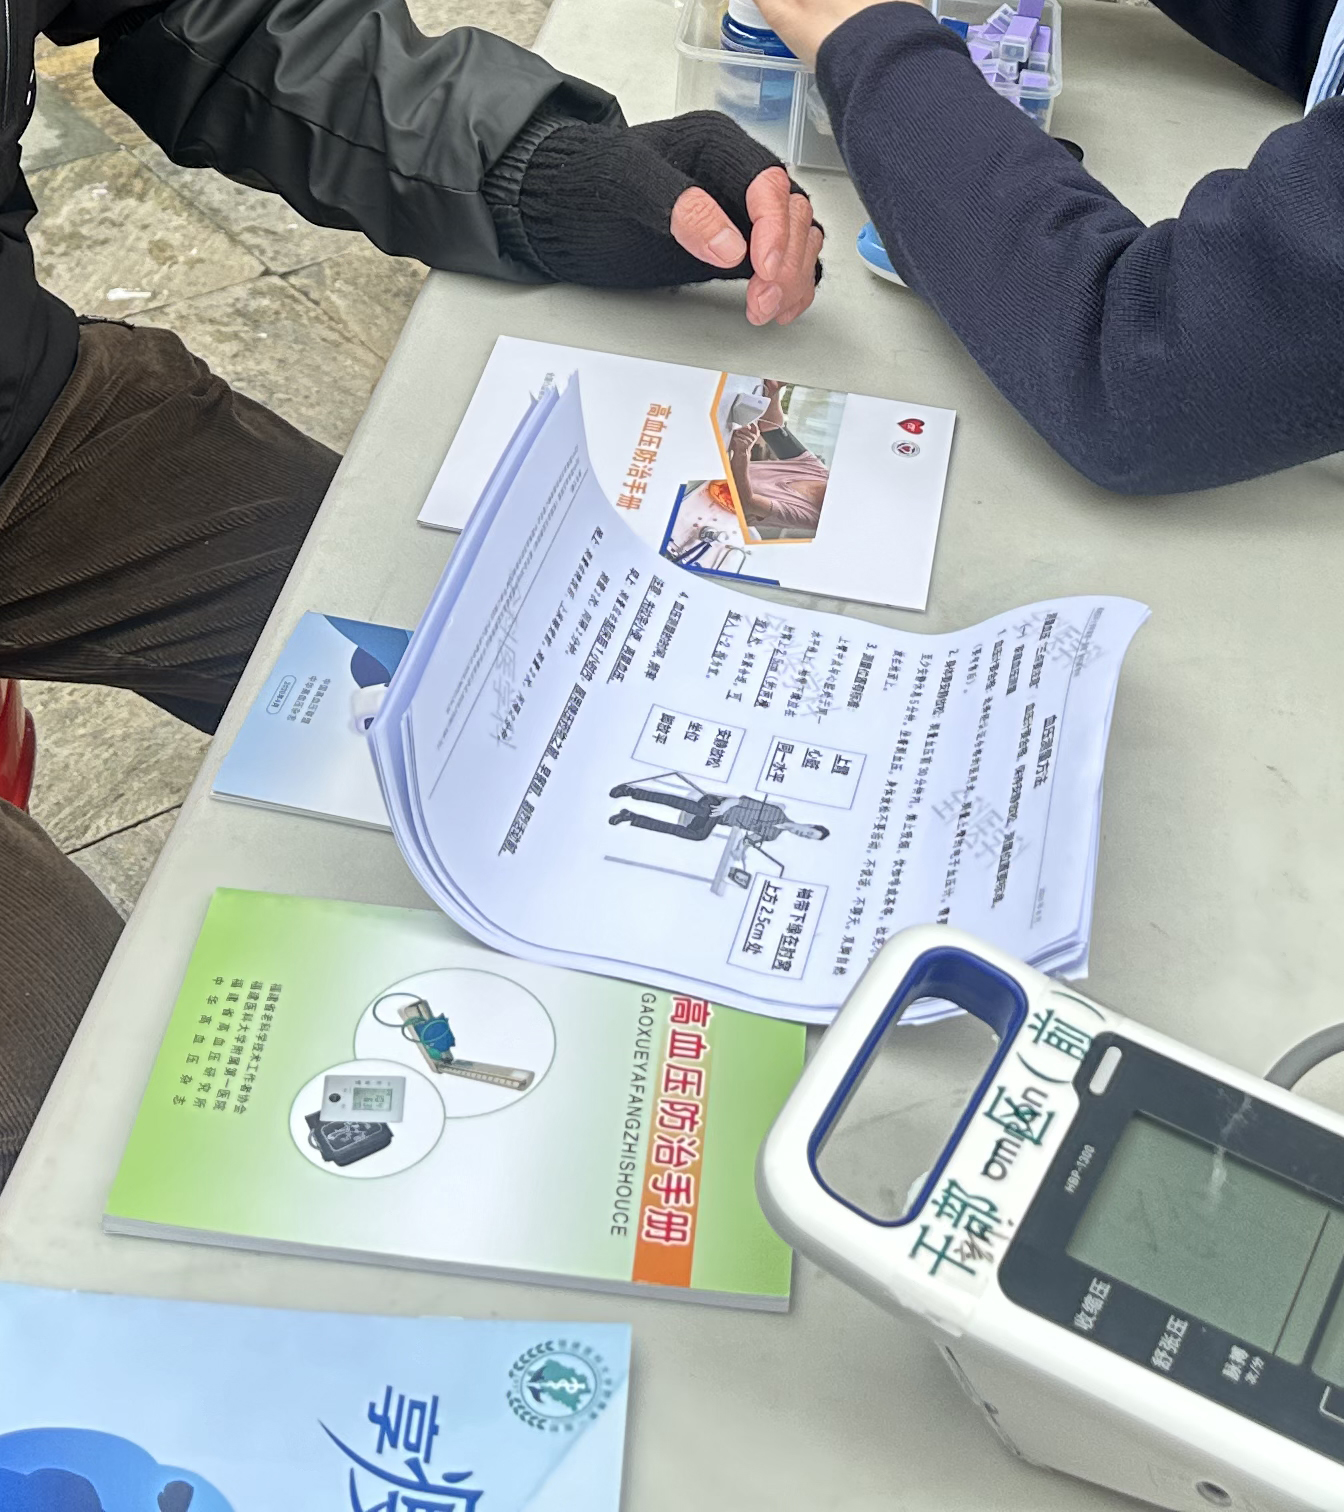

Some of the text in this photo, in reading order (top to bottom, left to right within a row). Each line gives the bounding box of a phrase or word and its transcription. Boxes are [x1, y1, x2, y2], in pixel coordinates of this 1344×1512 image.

[616, 402, 673, 511] 高血压防治手册
[765, 740, 795, 784] 同一水平
[801, 746, 822, 772] 心脏
[831, 753, 853, 777] 上臂
[1033, 714, 1059, 790] 血压测量方法
[771, 887, 814, 974] 袖带下缘在肘窝
[172, 976, 225, 1106] 中华高血压杂志
[192, 978, 245, 1109] 福建省高血压研究所
[212, 980, 264, 1112] 福建医科大学附属第一医院
[233, 982, 284, 1115] 福建省老科学技术工作者协会
[610, 991, 657, 1238] GAOXUEYAFANGZHISHOUCE
[642, 994, 712, 1246] 高血压防治手册
[1064, 1144, 1096, 1195] HBP-1300
[1074, 1277, 1112, 1332] 收缩压
[1150, 1314, 1189, 1372] 舒张压
[1222, 1344, 1250, 1384] 脉搏
